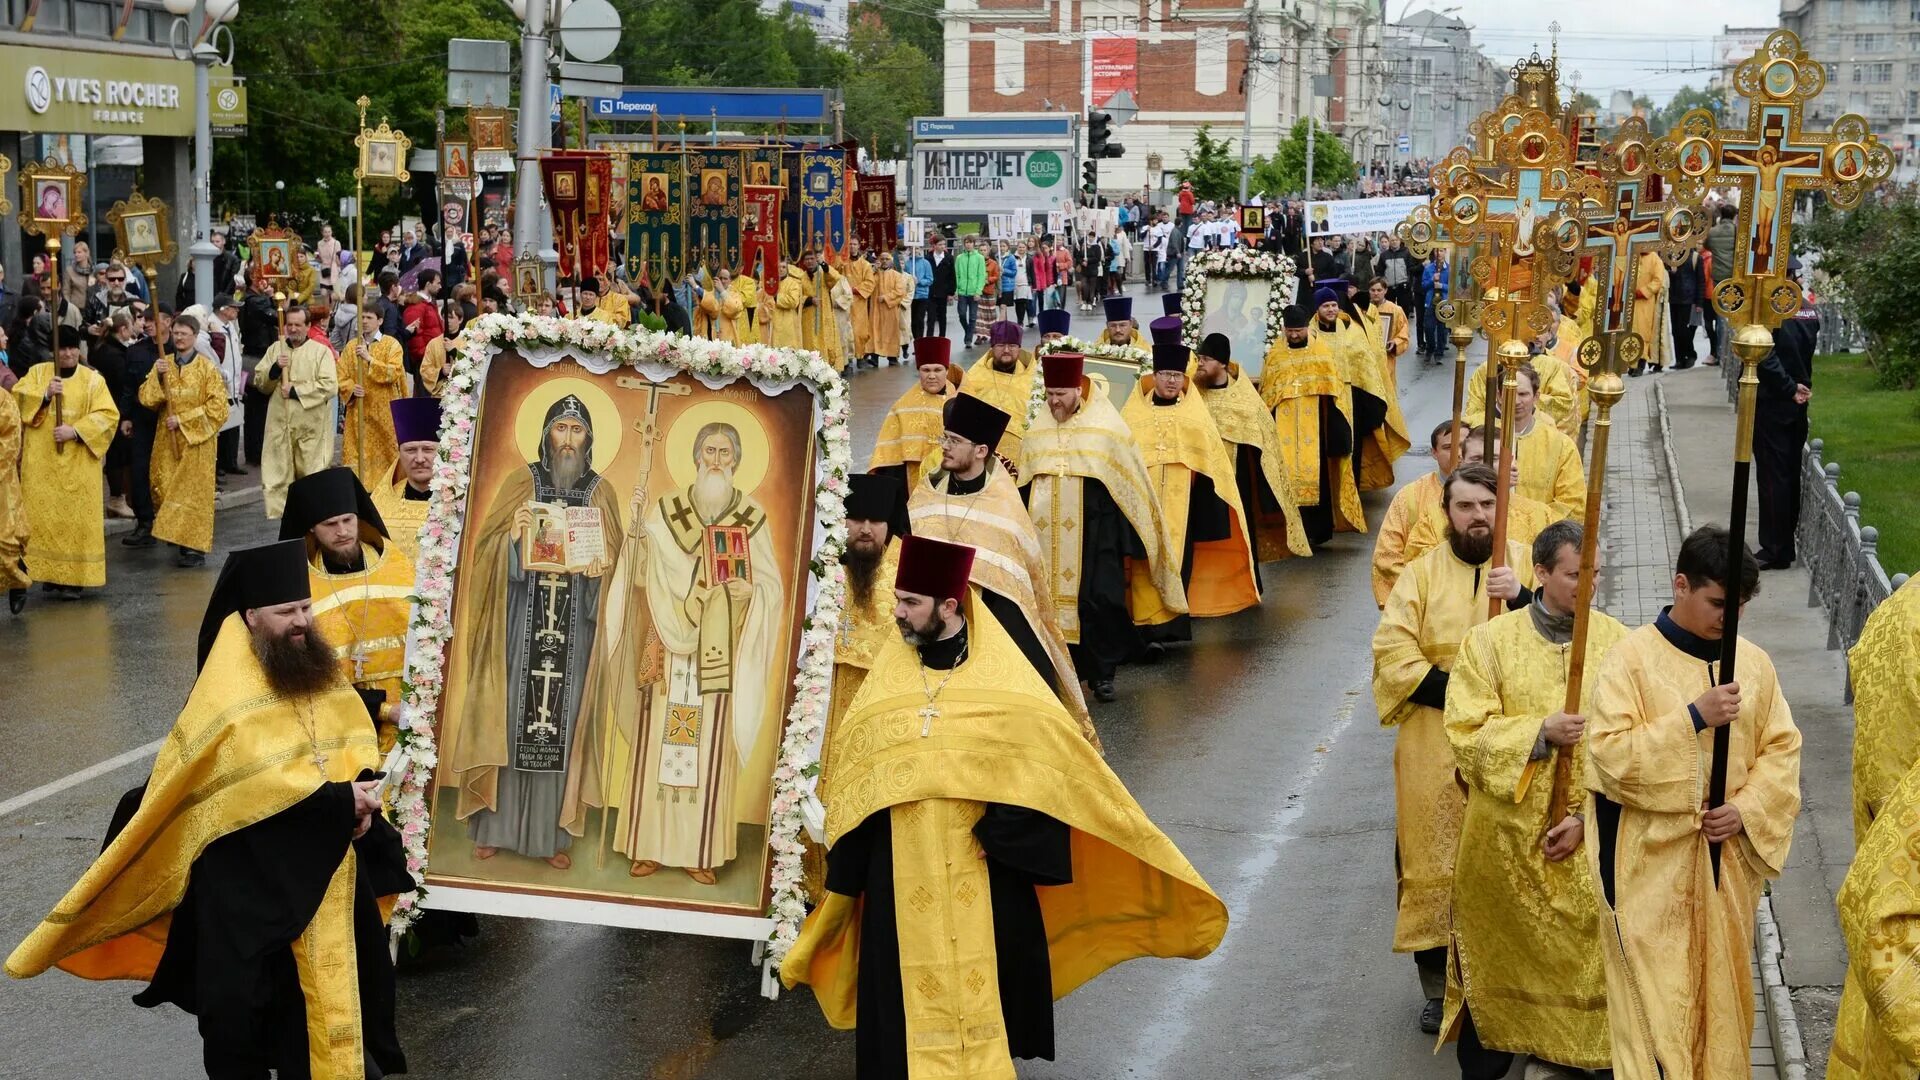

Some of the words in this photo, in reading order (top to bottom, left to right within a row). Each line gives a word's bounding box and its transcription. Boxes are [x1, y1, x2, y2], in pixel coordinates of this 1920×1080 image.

[54, 76, 101, 104] YVES
[106, 80, 180, 108] ROCHER
[616, 101, 658, 112] Переход
[93, 109, 144, 124] FRANCE
[924, 151, 1025, 177] ИНТЕРНЕТ
[1029, 161, 1050, 173] 600
[923, 178, 946, 190] ДЛЯ
[948, 177, 1004, 190] ПЛАНШТА
